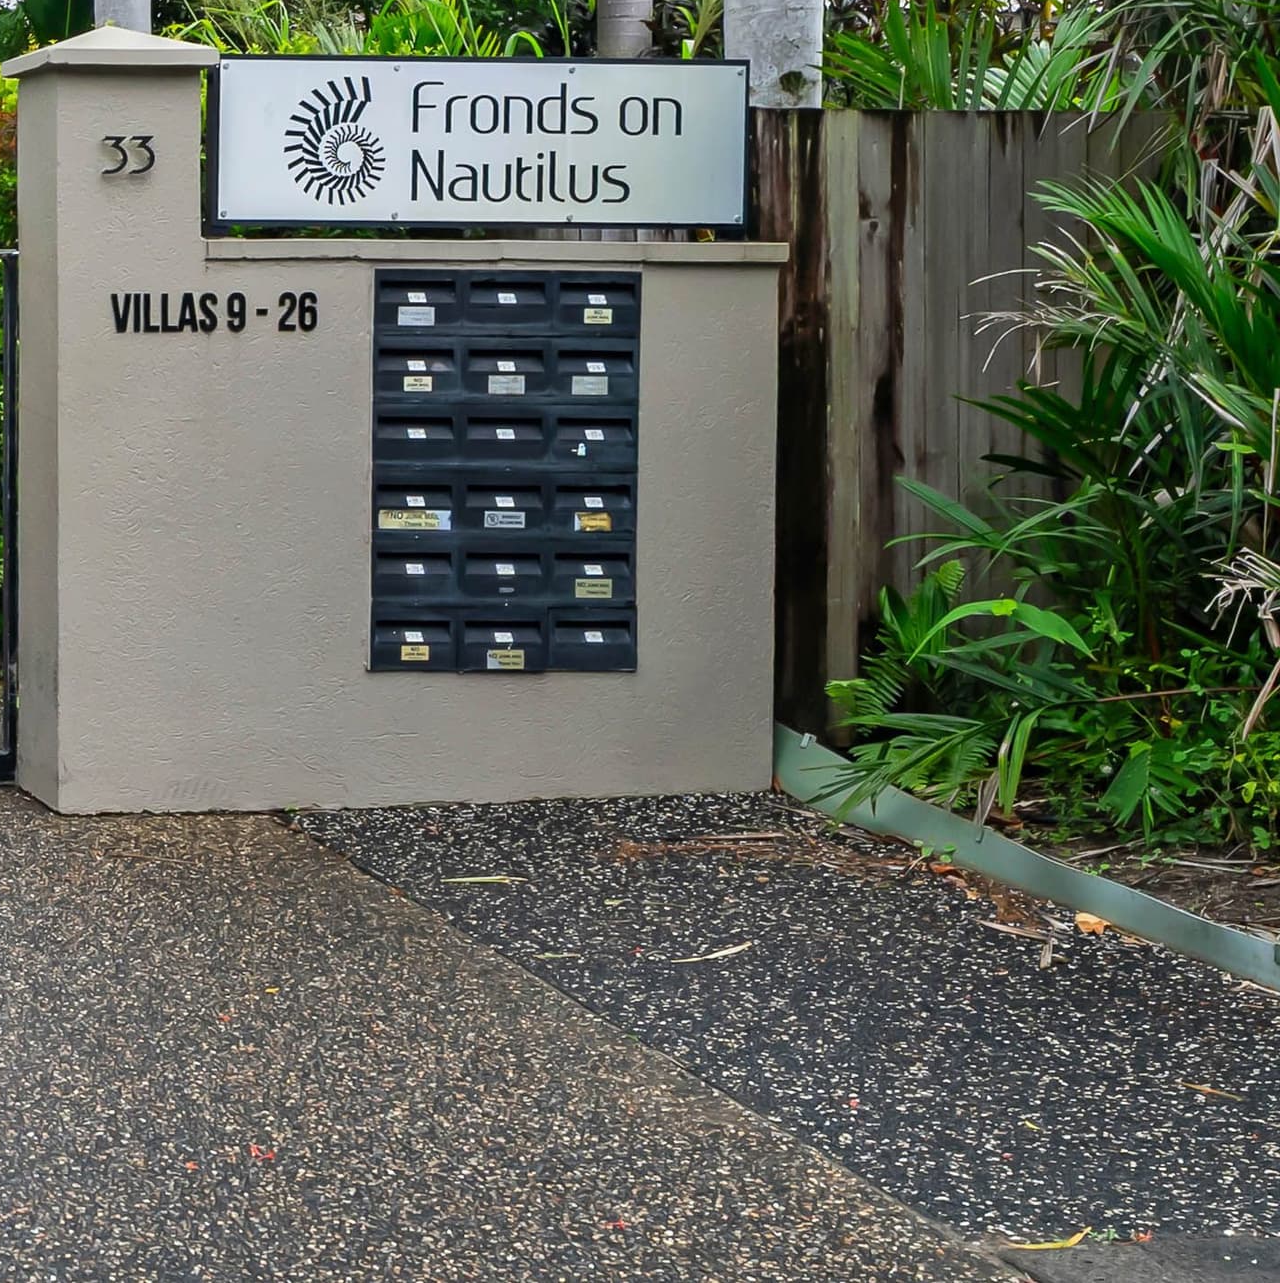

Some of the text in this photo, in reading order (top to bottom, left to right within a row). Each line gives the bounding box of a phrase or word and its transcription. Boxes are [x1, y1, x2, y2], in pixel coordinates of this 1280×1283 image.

[412, 81, 683, 137] Fronds on
[101, 135, 156, 175] 33
[411, 149, 631, 204] Nautilus
[110, 291, 319, 335] VILLAS 9 - 26
